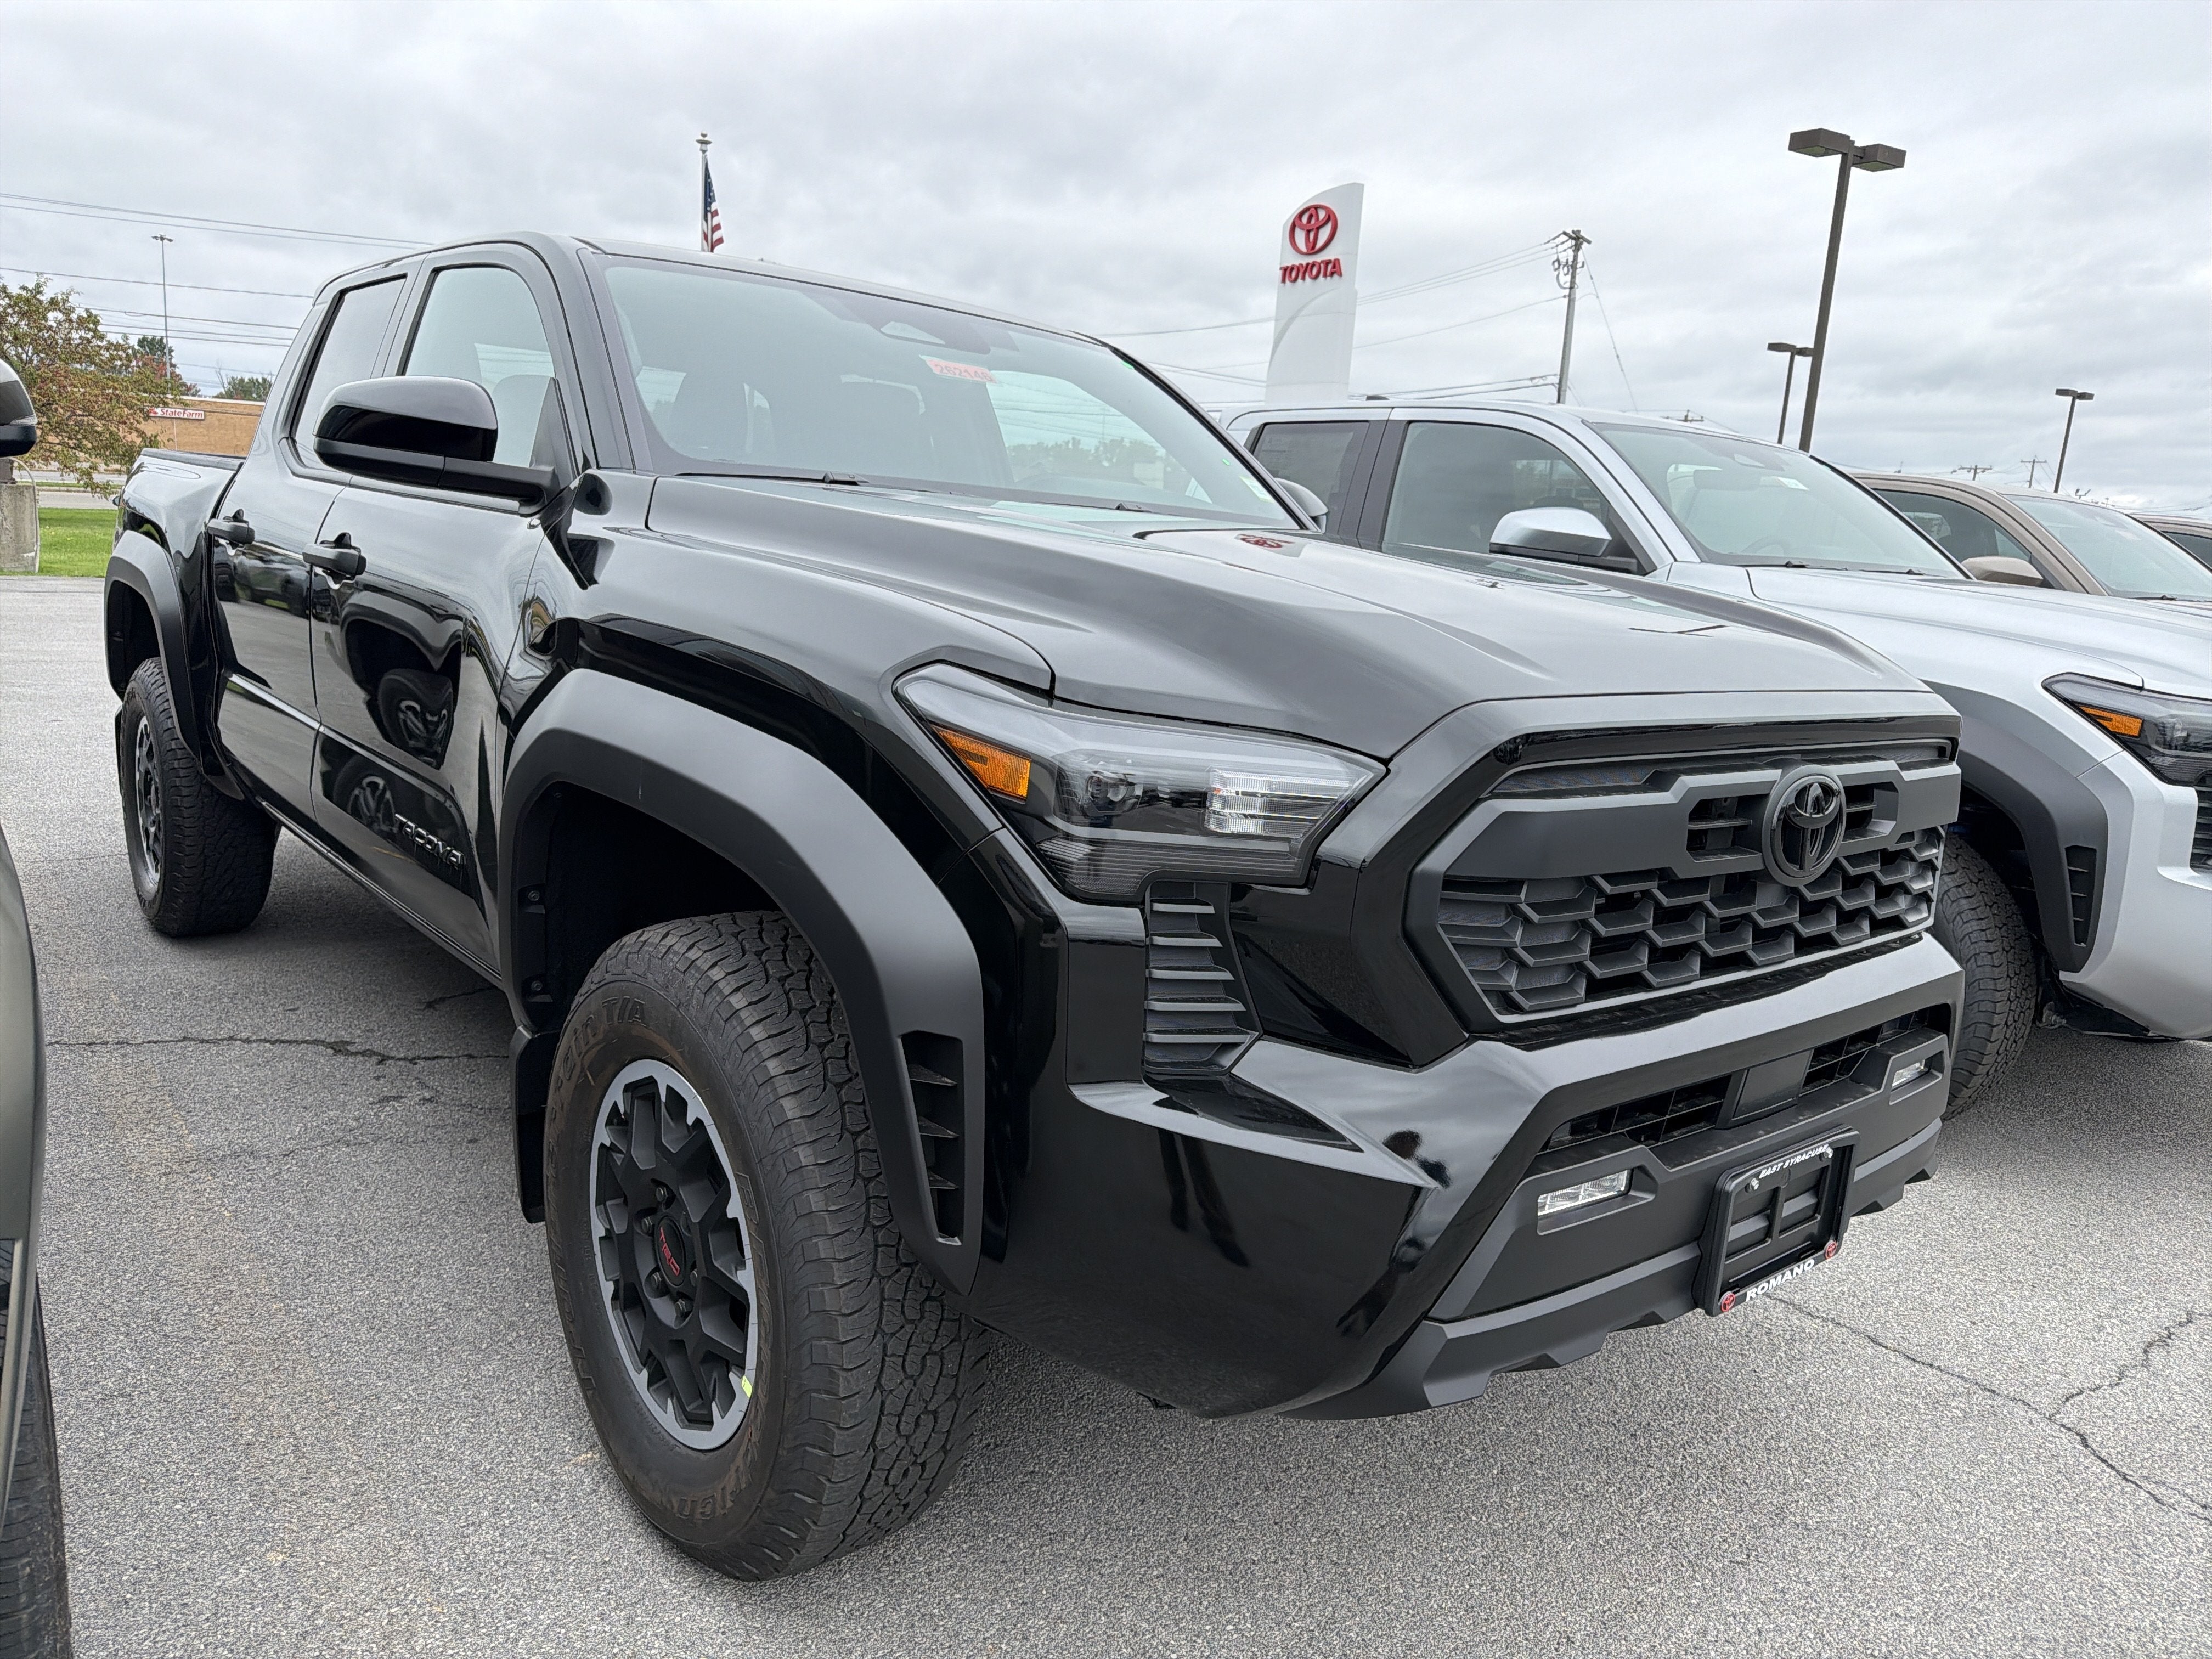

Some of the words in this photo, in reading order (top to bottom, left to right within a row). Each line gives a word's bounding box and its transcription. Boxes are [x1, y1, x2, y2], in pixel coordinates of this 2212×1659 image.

[1279, 258, 1342, 284] TOYOTA
[934, 364, 993, 382] 262146
[394, 813, 466, 869] TACOMA
[601, 995, 650, 1029] T/A
[1759, 1162, 1784, 1179] EAST
[1782, 1143, 1829, 1169] SYRACUSE
[658, 1226, 681, 1277] TRD
[1746, 1259, 1815, 1302] ROMANO
